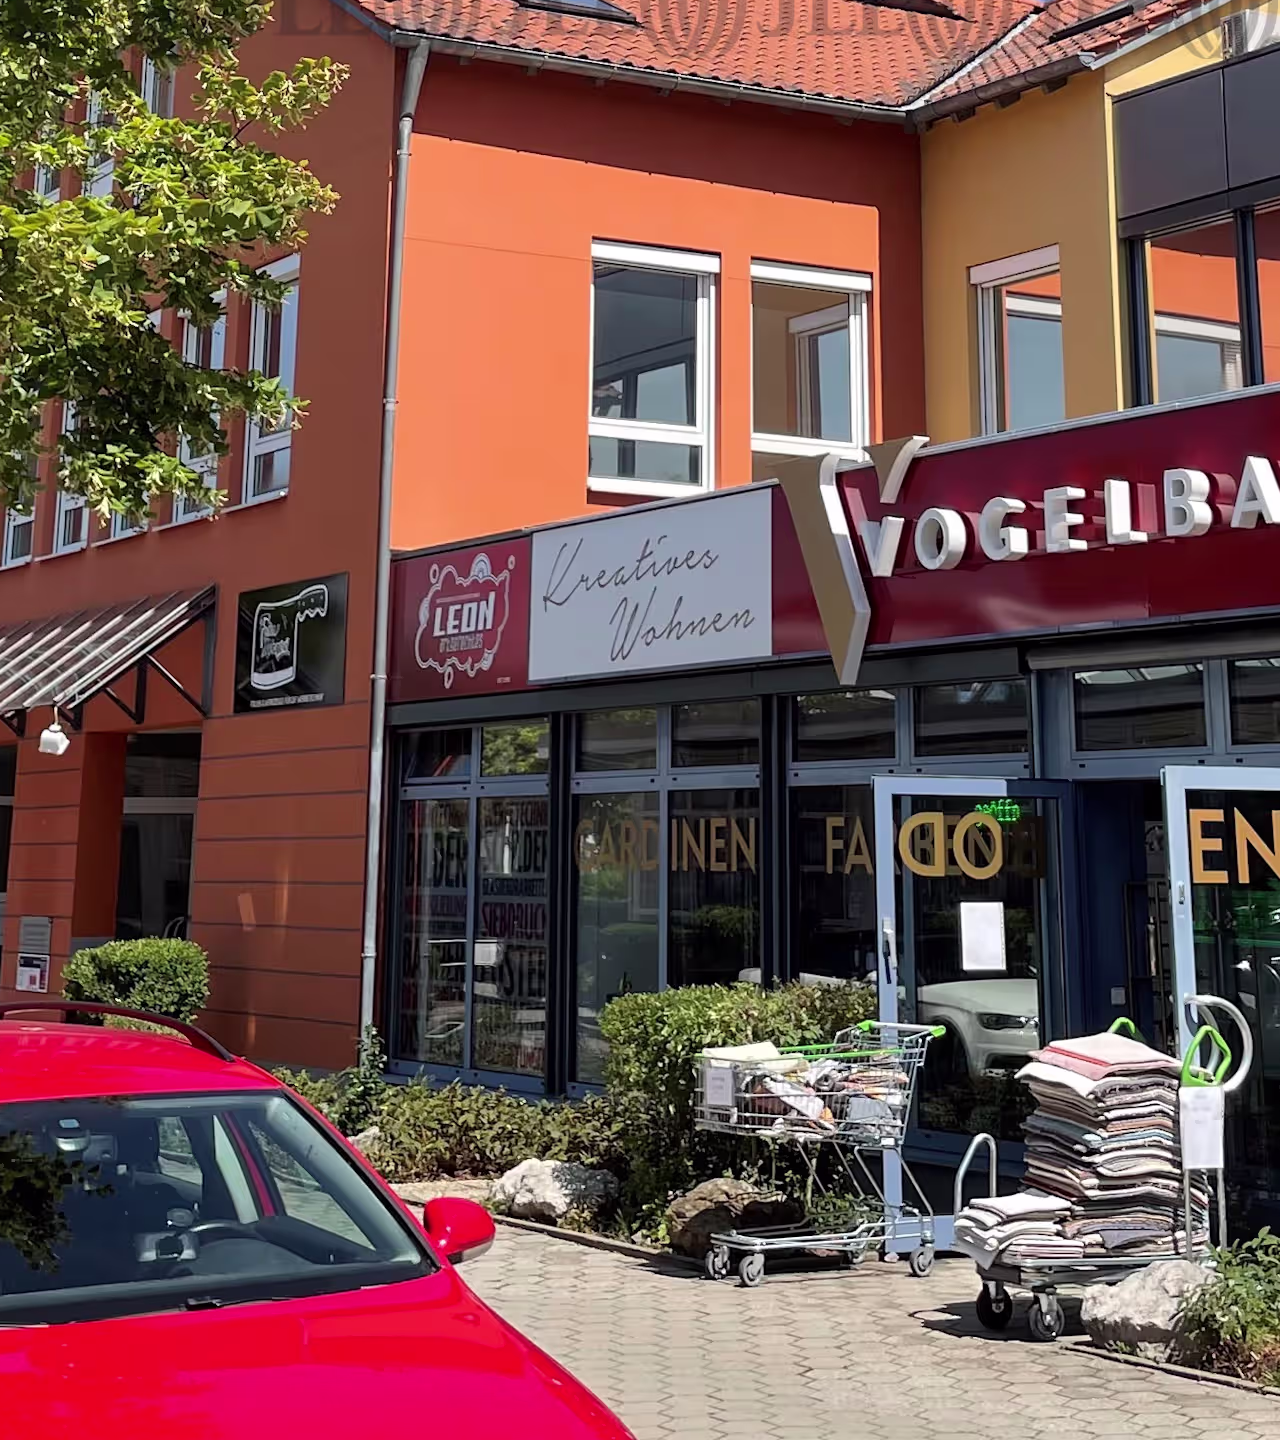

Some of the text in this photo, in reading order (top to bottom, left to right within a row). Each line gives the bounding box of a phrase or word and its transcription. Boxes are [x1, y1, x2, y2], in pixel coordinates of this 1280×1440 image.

[543, 535, 719, 612] Kreatives
[433, 591, 496, 637] LEON
[609, 586, 755, 661] Wohnen
